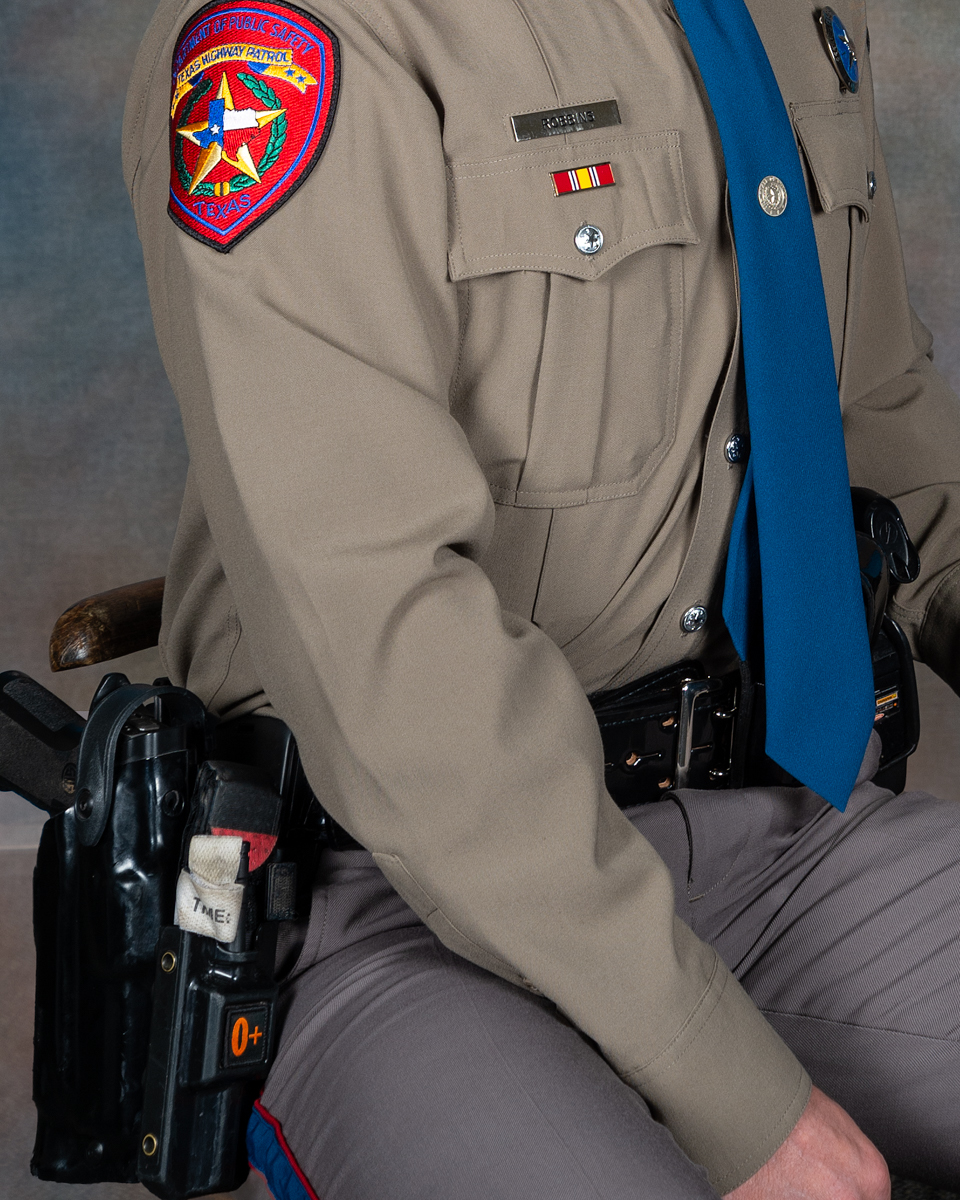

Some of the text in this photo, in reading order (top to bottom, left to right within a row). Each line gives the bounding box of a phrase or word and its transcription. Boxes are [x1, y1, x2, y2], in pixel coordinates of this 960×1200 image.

[214, 17, 227, 34] OF
[229, 16, 270, 33] PUBLIC
[270, 23, 315, 55] SAFETY
[178, 46, 290, 84] TEXAS HIGHWAY PATROL
[542, 111, 595, 128] ROBBINS
[192, 194, 250, 219] TEXAS
